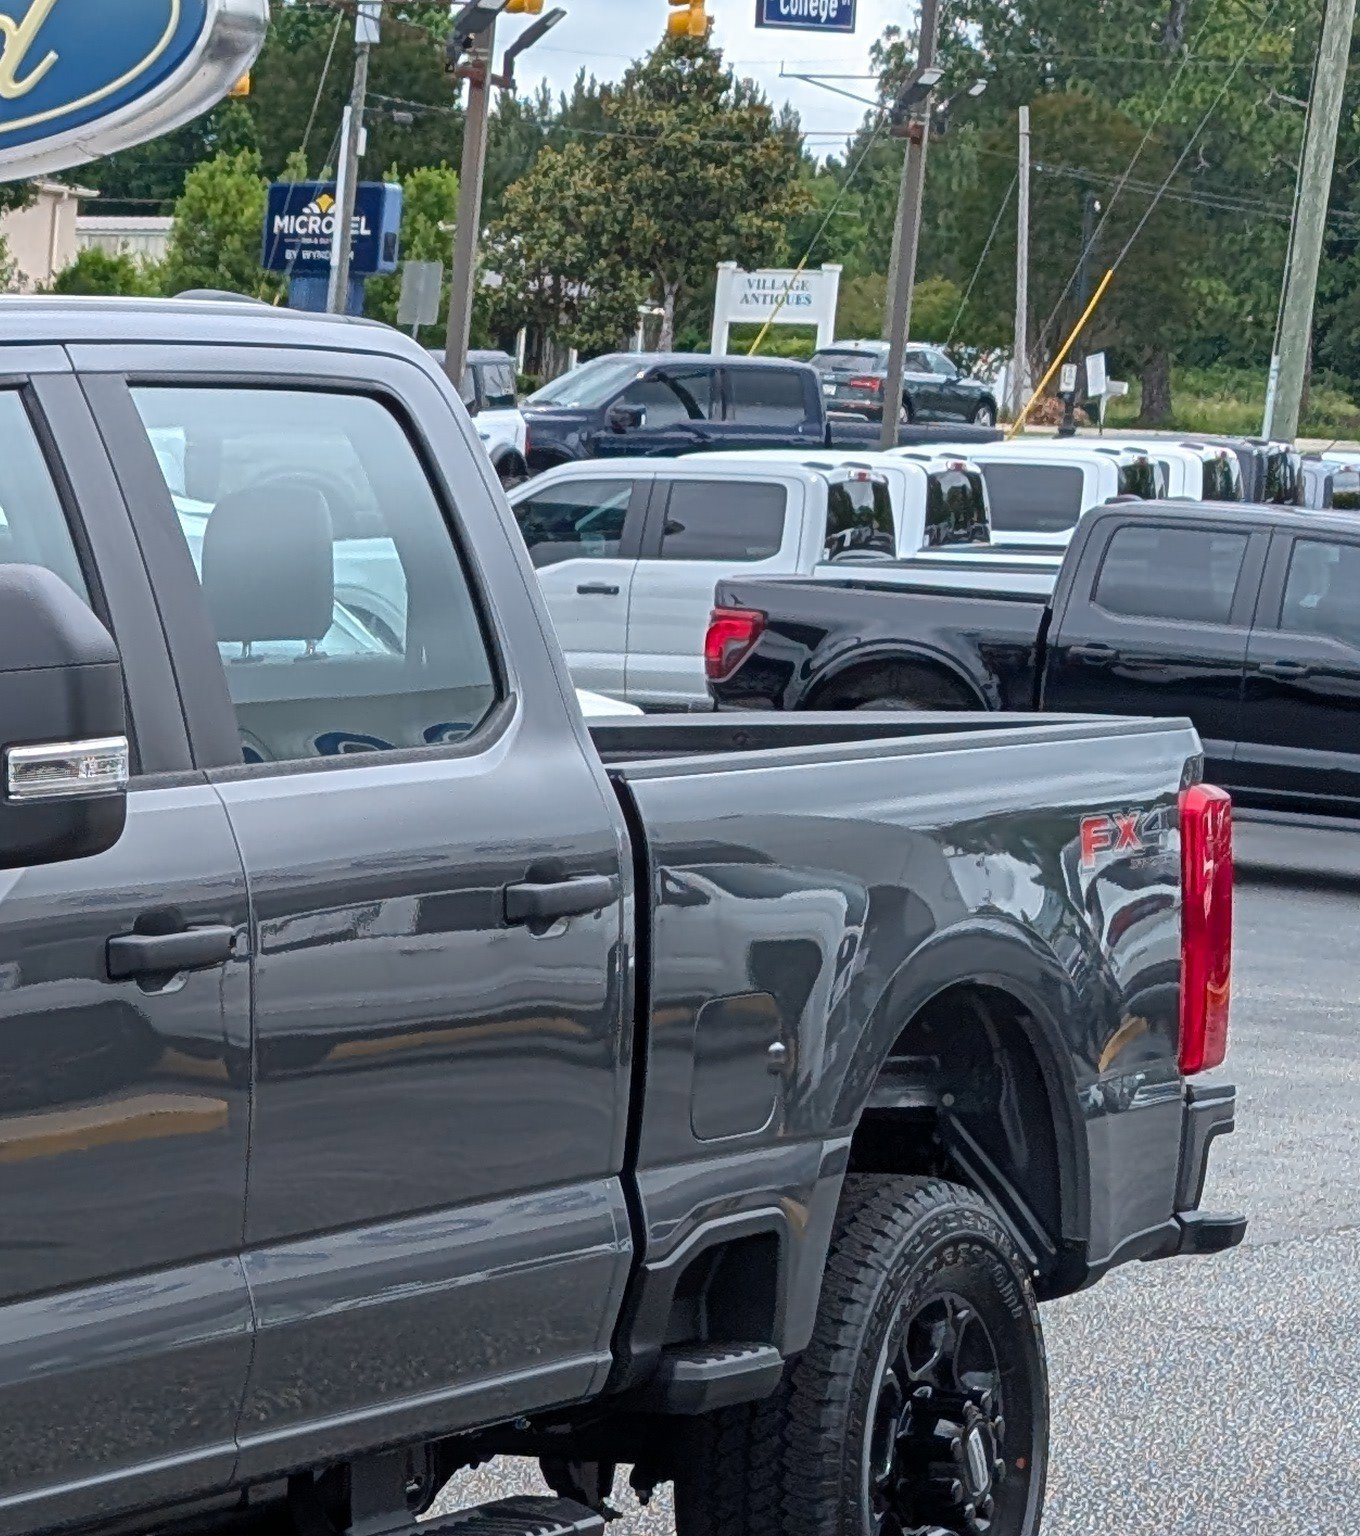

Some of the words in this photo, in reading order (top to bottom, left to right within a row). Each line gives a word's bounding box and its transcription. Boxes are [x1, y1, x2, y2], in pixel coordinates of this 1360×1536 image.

[273, 214, 372, 236] MICROEL
[746, 278, 811, 291] VILLAGE
[739, 292, 813, 307] ANTIQUES
[1079, 805, 1171, 870] FX4
